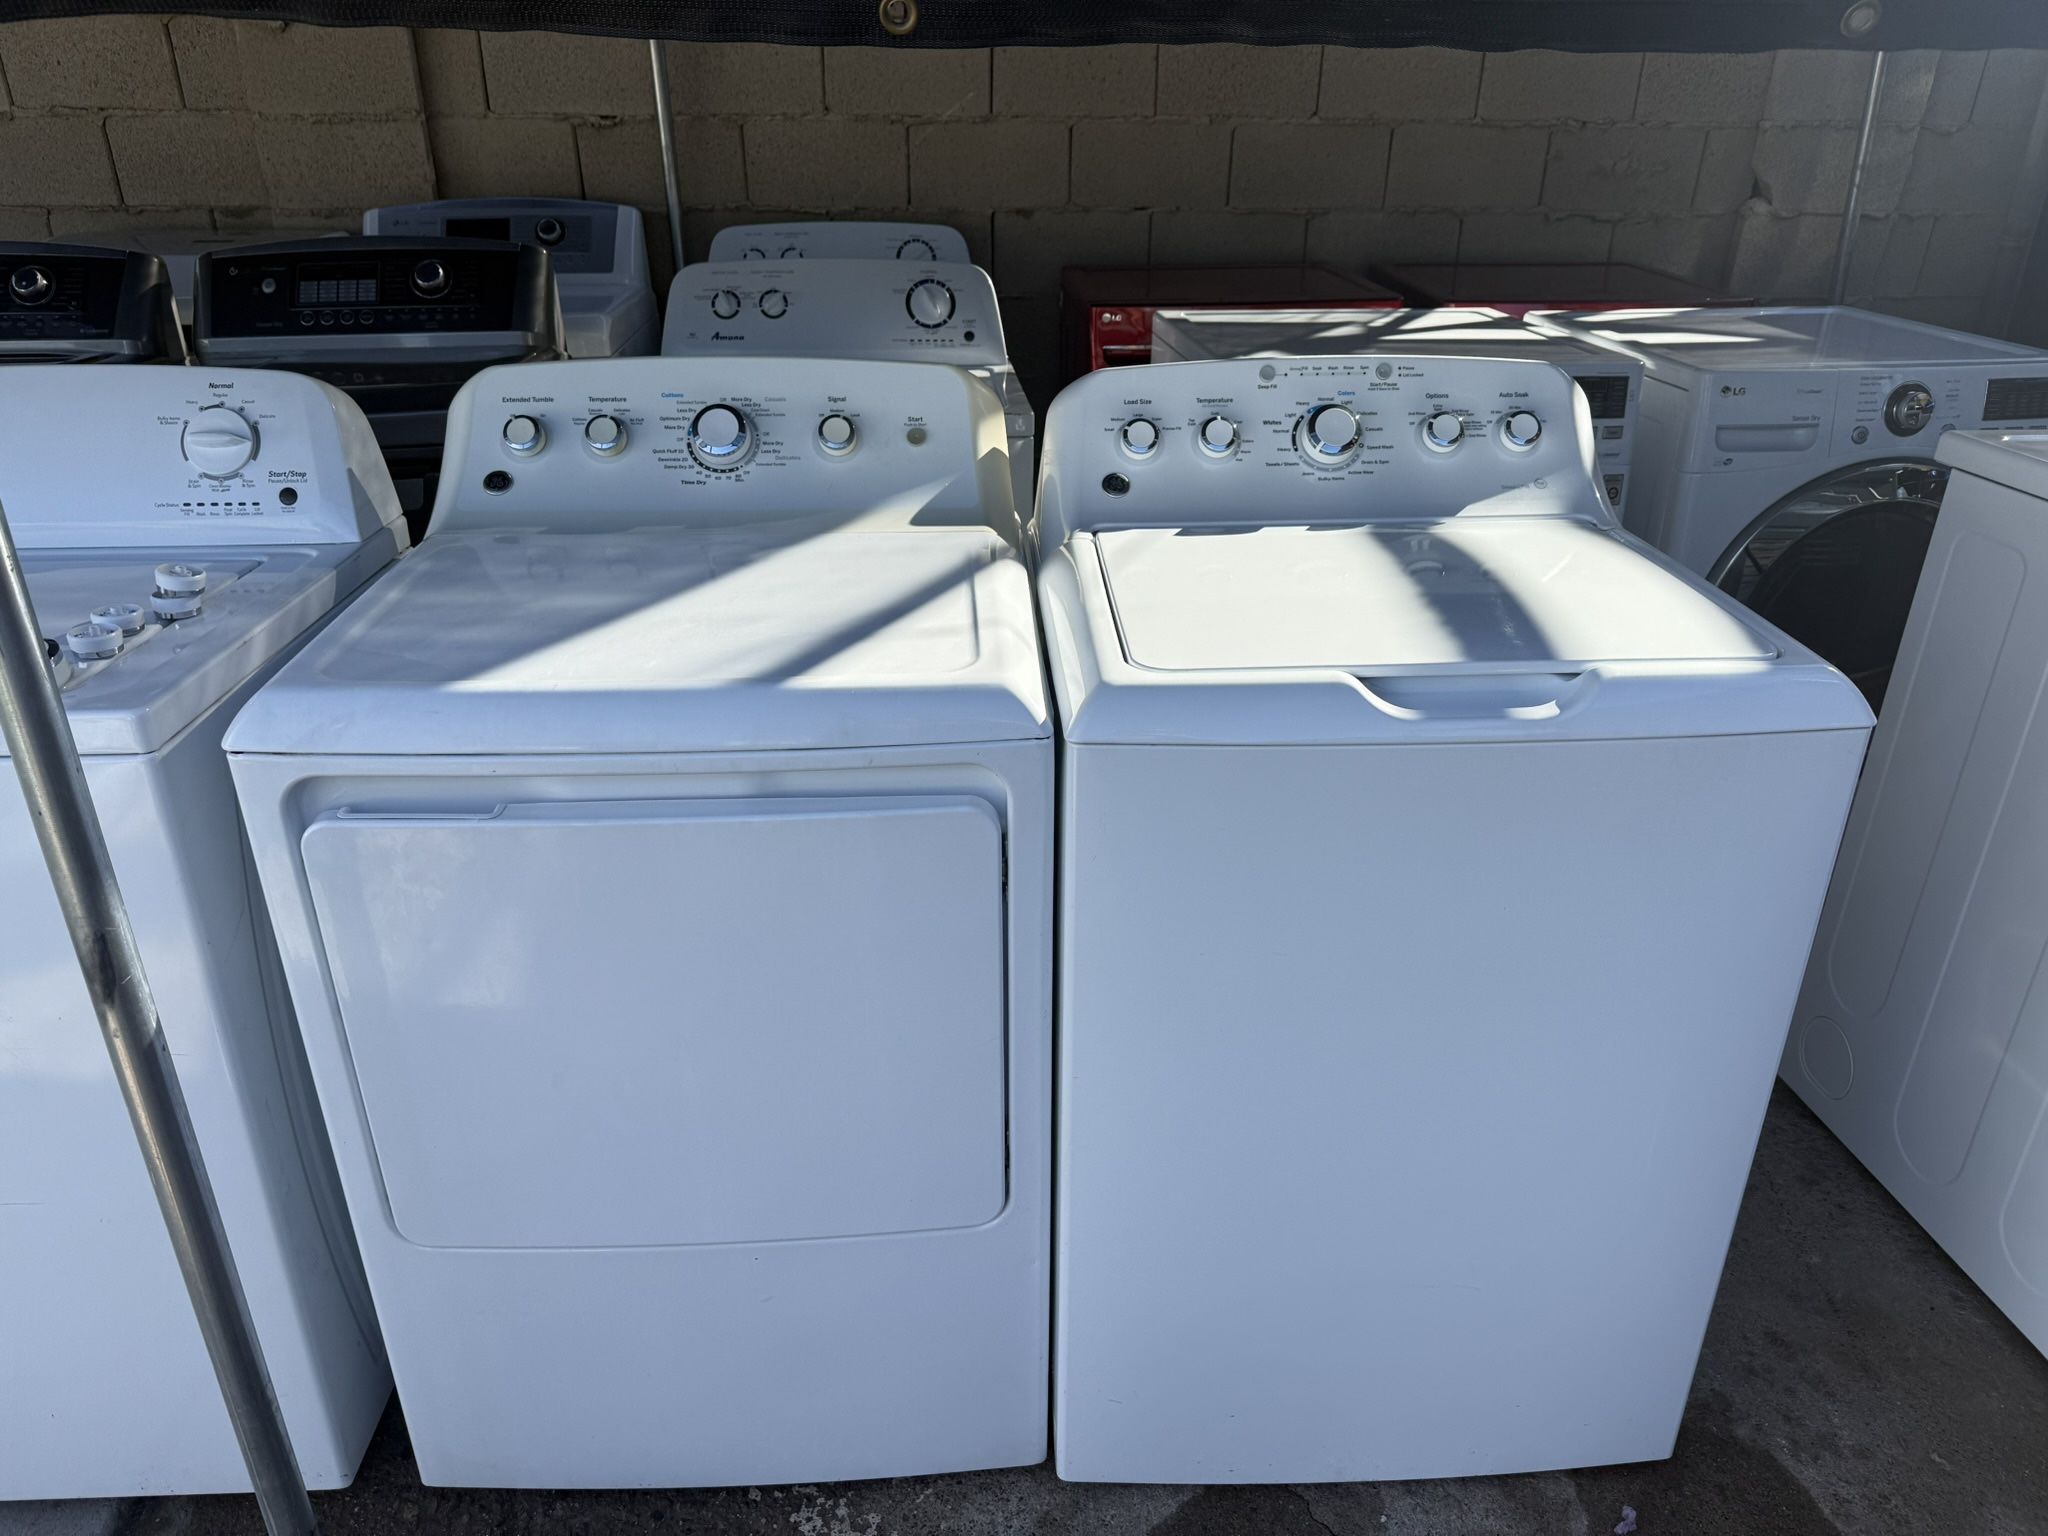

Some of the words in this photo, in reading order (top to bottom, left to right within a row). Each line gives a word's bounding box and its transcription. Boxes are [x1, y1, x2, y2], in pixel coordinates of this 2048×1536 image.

[711, 330, 745, 341] Amana
[1733, 387, 1746, 396] LG
[268, 470, 307, 479] Start/Stop
